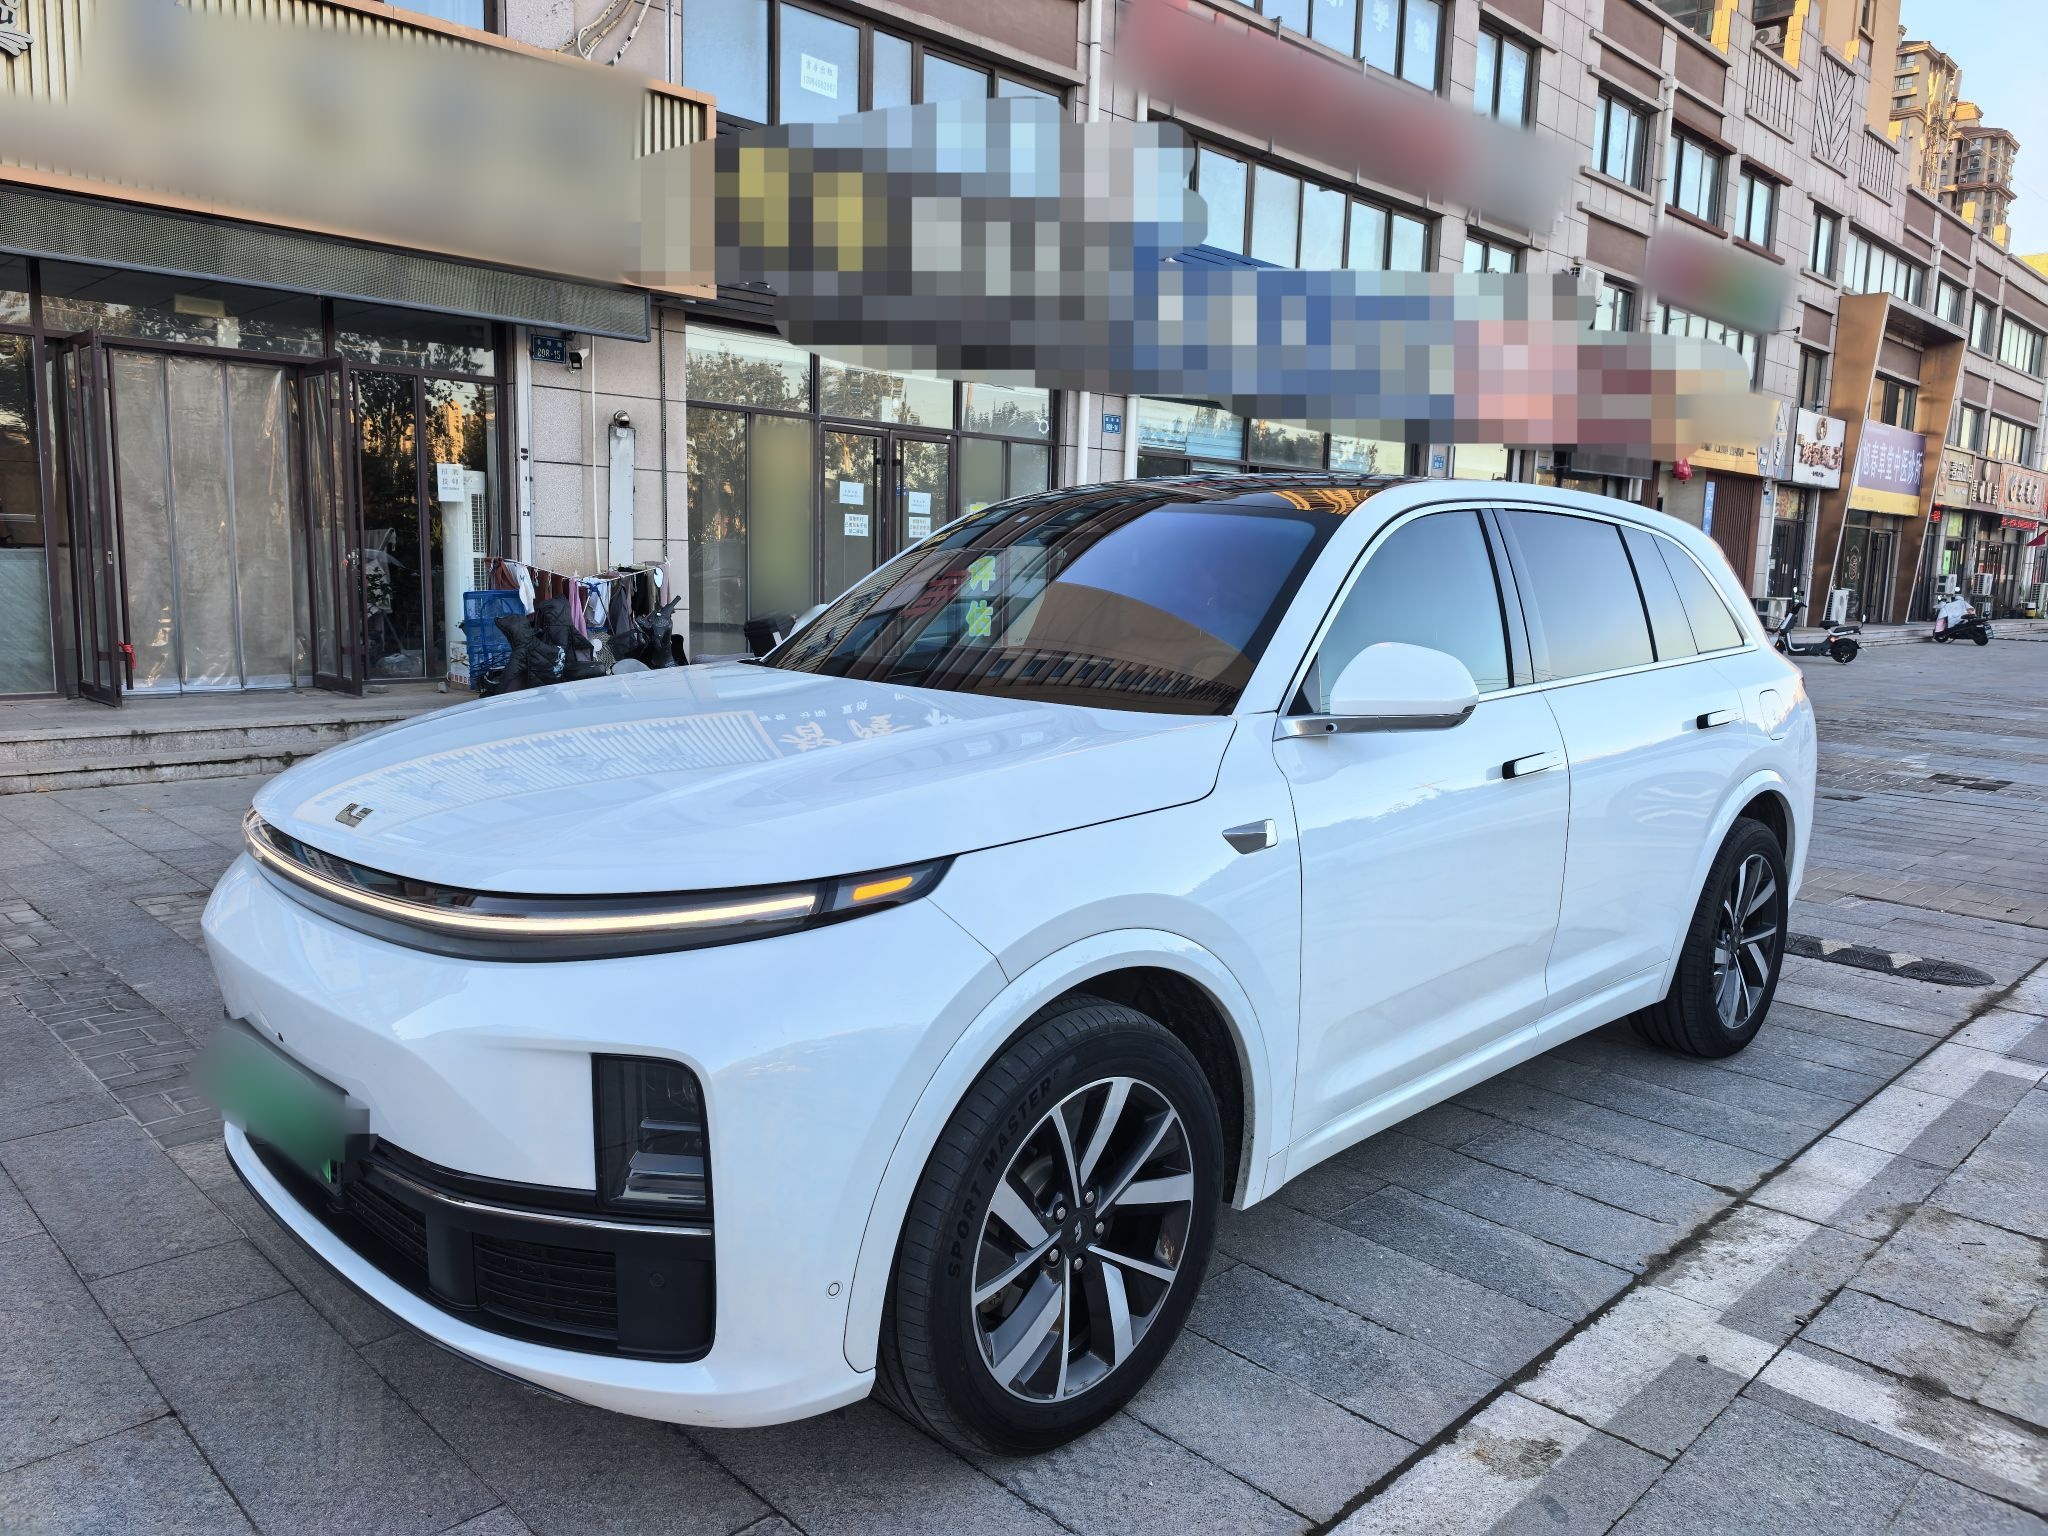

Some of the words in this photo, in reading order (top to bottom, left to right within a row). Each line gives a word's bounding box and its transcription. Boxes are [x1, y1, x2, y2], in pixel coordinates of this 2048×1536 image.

[966, 556, 996, 637] 评估
[948, 1180, 983, 1279] SPORT
[983, 1078, 1053, 1173] MASTER
